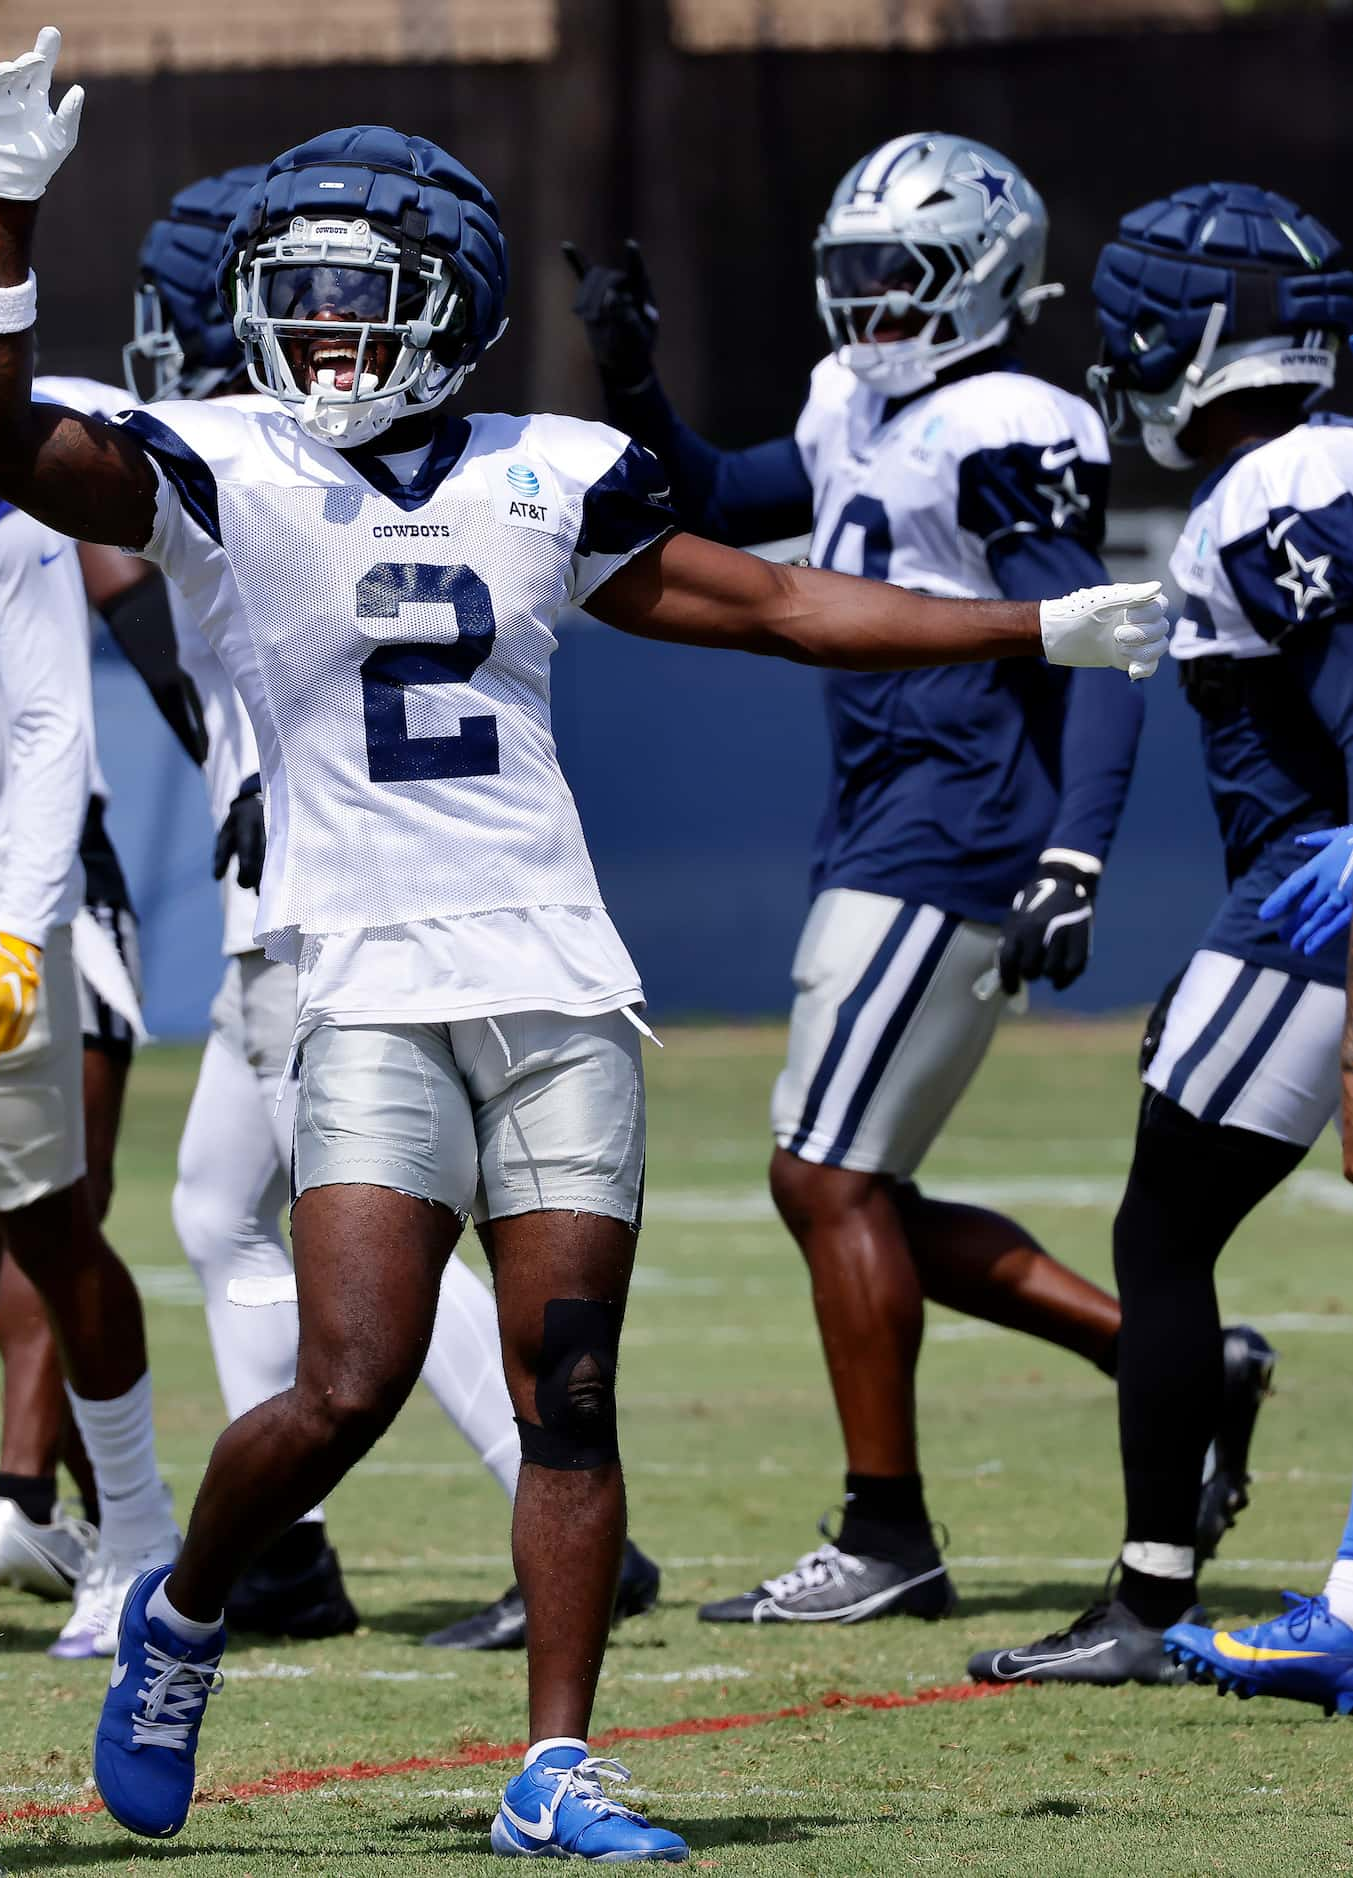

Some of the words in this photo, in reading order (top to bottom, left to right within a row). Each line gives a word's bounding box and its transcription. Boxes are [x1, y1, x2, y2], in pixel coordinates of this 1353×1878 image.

[315, 226, 348, 235] COWBOYS
[509, 501, 548, 522] AT&T
[372, 524, 451, 538] COWBOYS
[355, 562, 501, 783] 2
